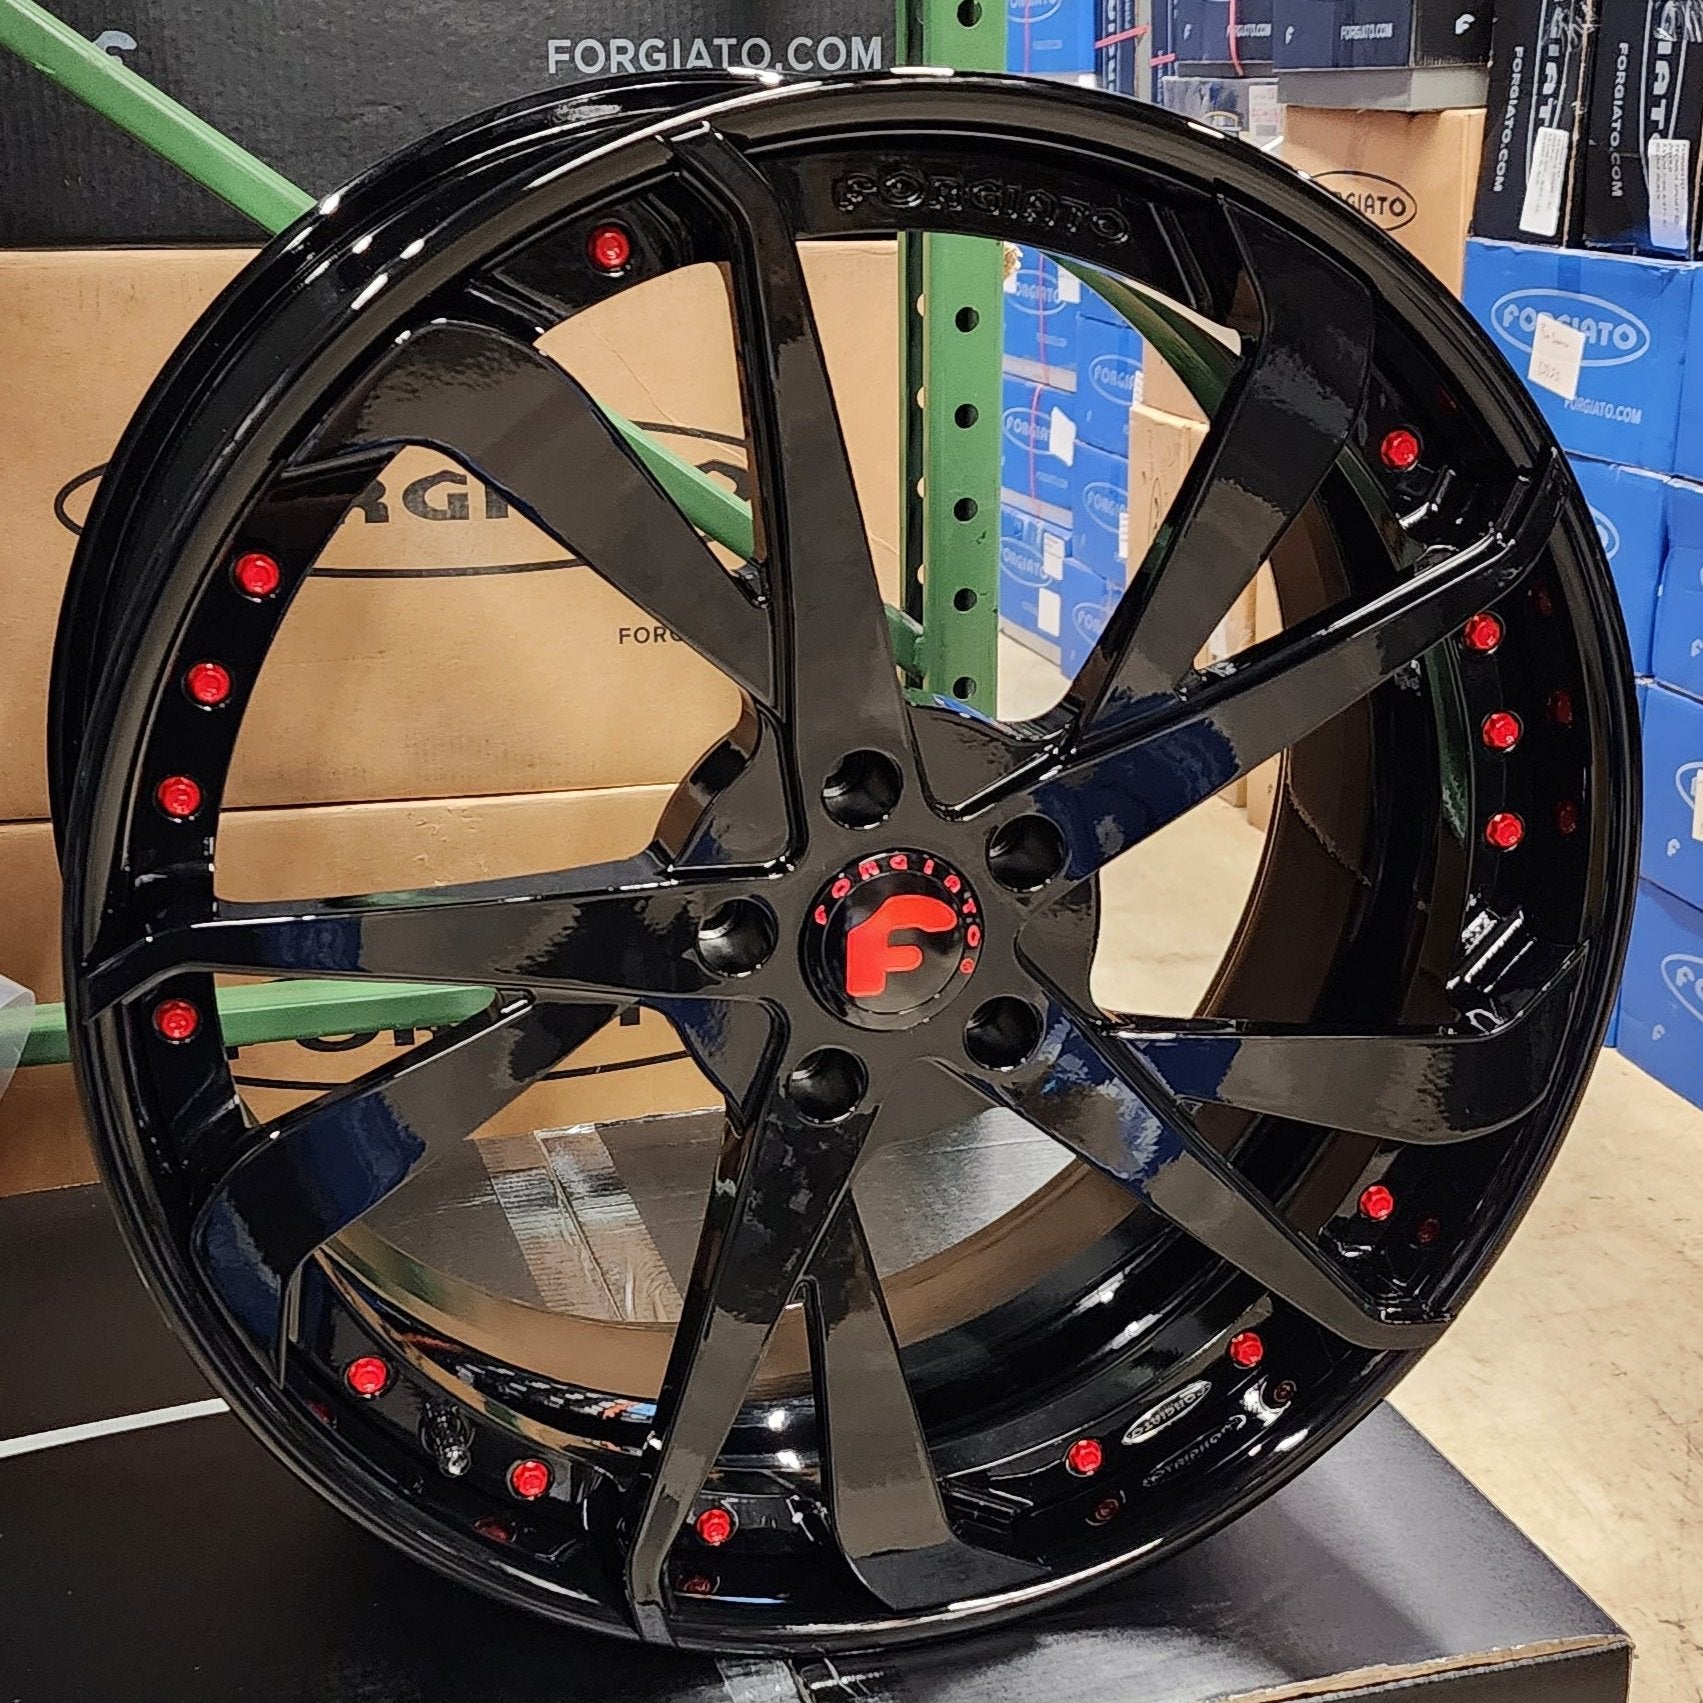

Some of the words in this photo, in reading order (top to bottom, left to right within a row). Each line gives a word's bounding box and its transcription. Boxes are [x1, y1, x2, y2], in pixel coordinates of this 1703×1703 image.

[547, 36, 882, 75] FORGIATO.COM
[1493, 46, 1525, 192] FORGIATO.COM
[1611, 42, 1629, 197] FORGIATO.COM
[832, 164, 1131, 244] FORGIATO
[846, 894, 959, 998] F
